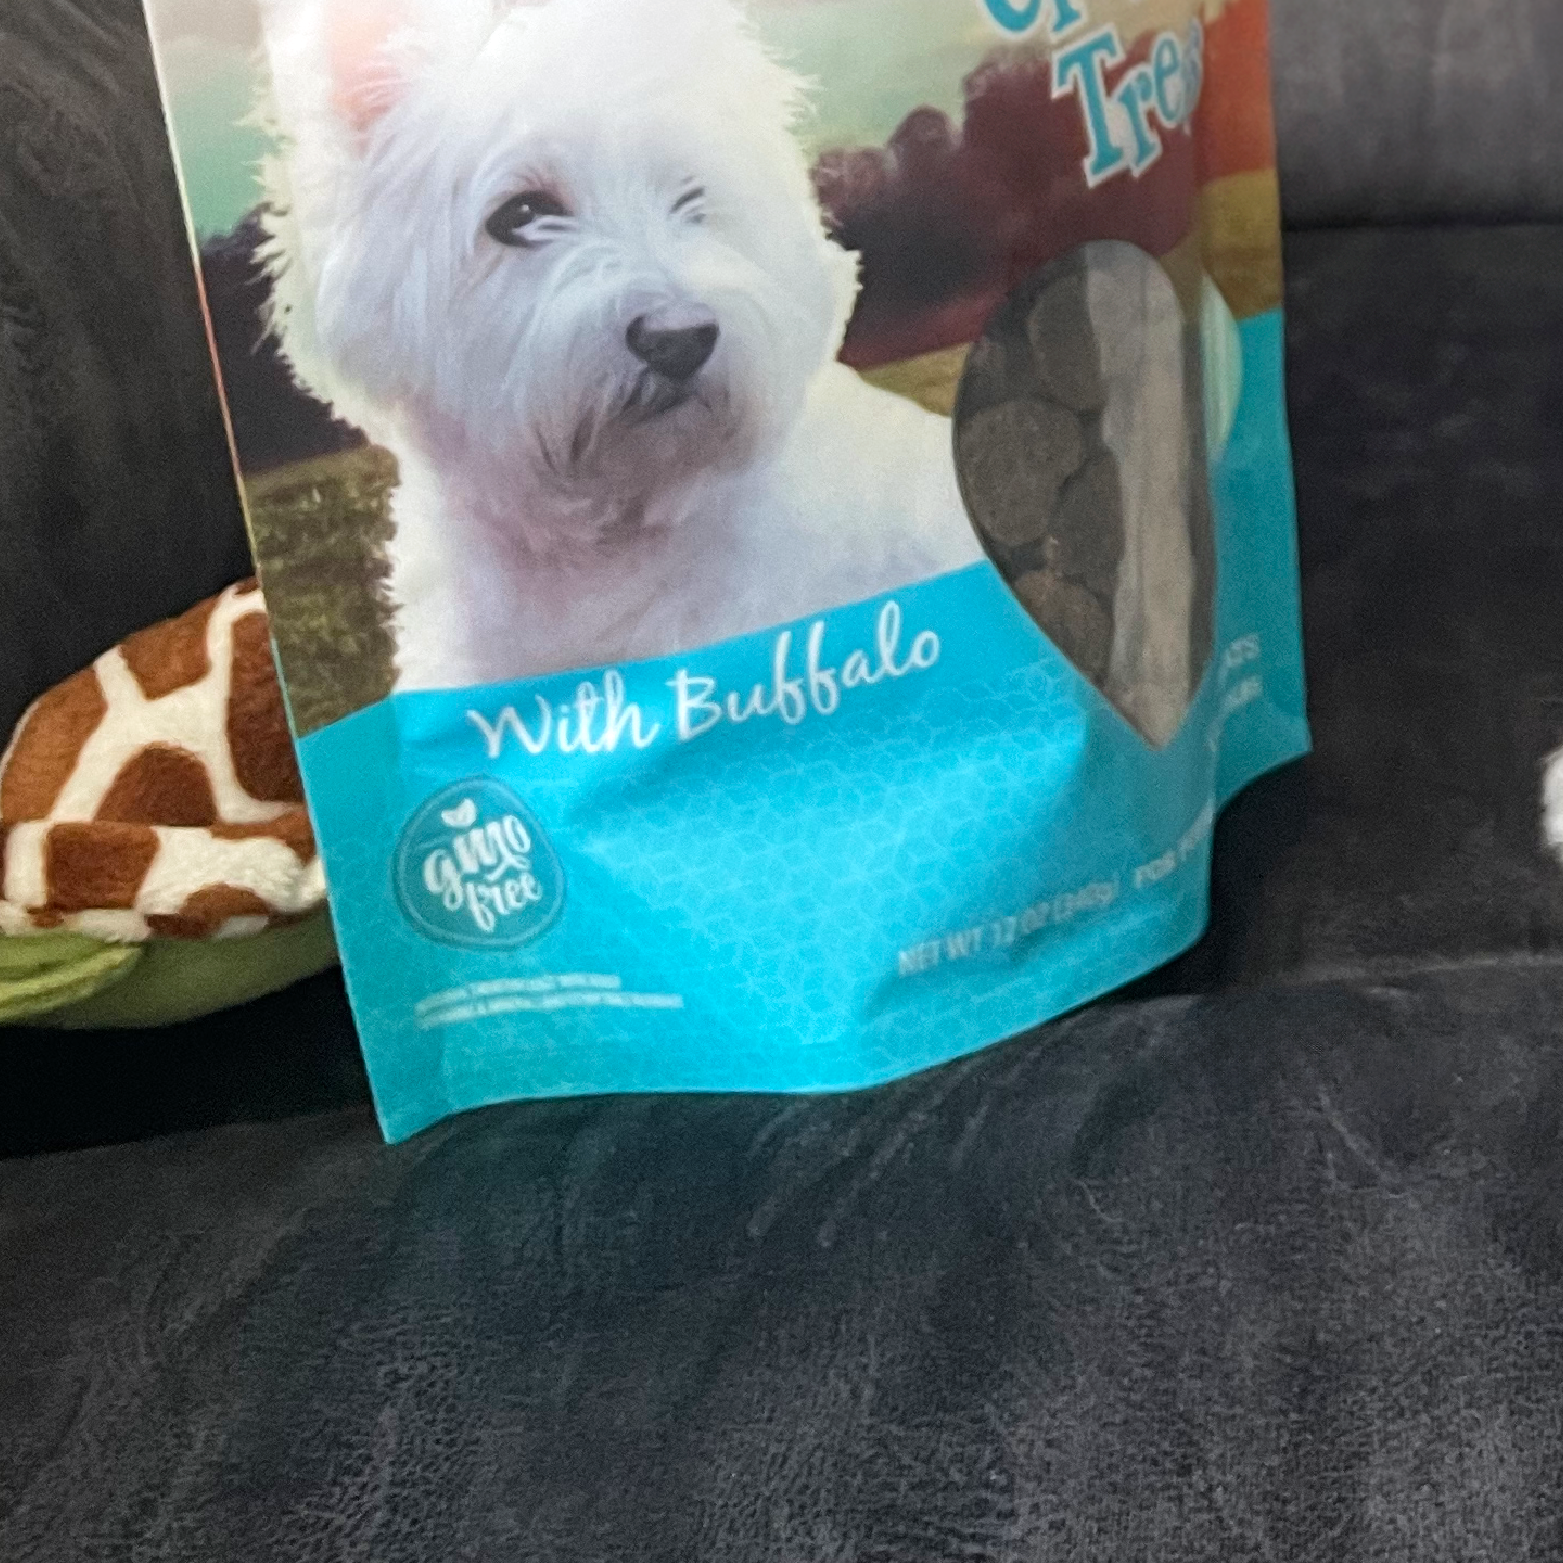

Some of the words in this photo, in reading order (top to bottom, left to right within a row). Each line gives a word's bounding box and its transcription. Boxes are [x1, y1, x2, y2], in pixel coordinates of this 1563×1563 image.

[466, 669, 660, 759] With
[665, 600, 940, 741] Buffalo
[422, 814, 531, 912] gmo
[464, 872, 543, 933] free
[899, 938, 941, 975] NET
[946, 926, 983, 960] WT
